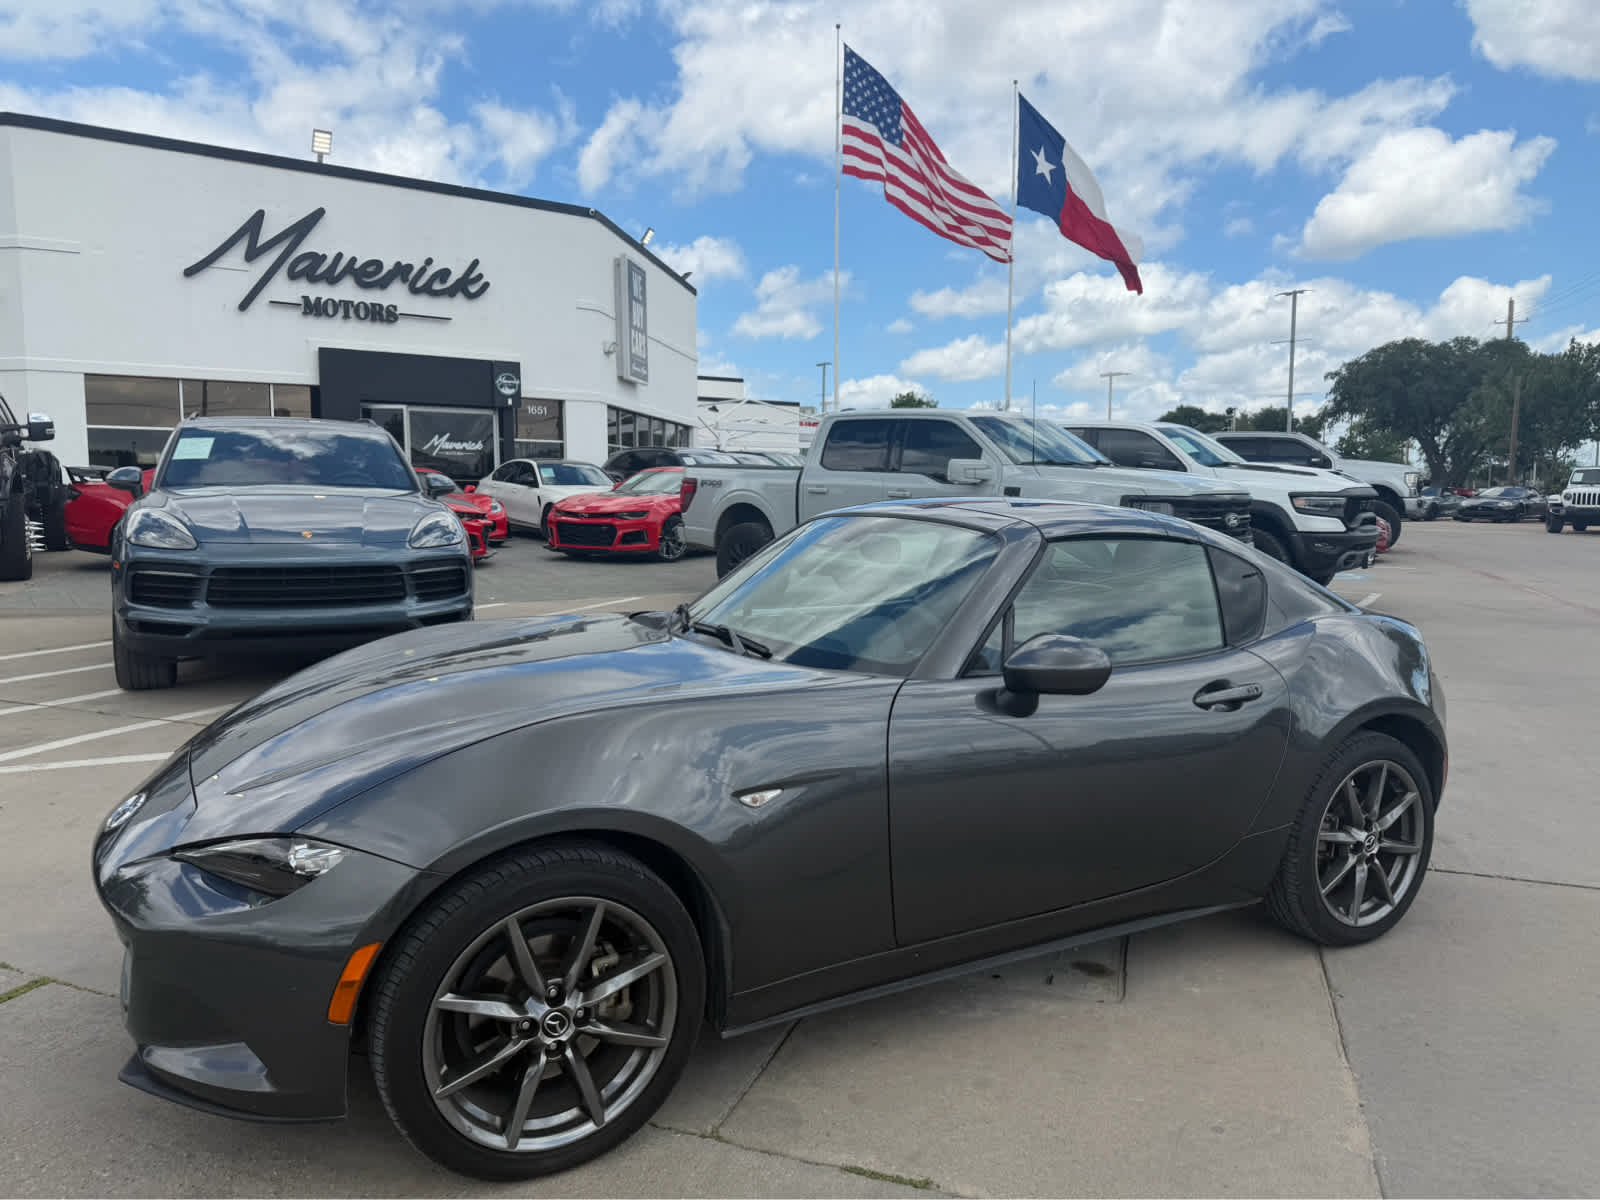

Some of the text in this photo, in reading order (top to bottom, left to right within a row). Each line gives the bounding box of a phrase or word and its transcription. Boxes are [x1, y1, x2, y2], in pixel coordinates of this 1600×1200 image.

[183, 207, 490, 312] Maverick
[301, 295, 400, 323] MOTORS
[527, 405, 548, 416] 1651
[422, 432, 484, 456] Maverick
